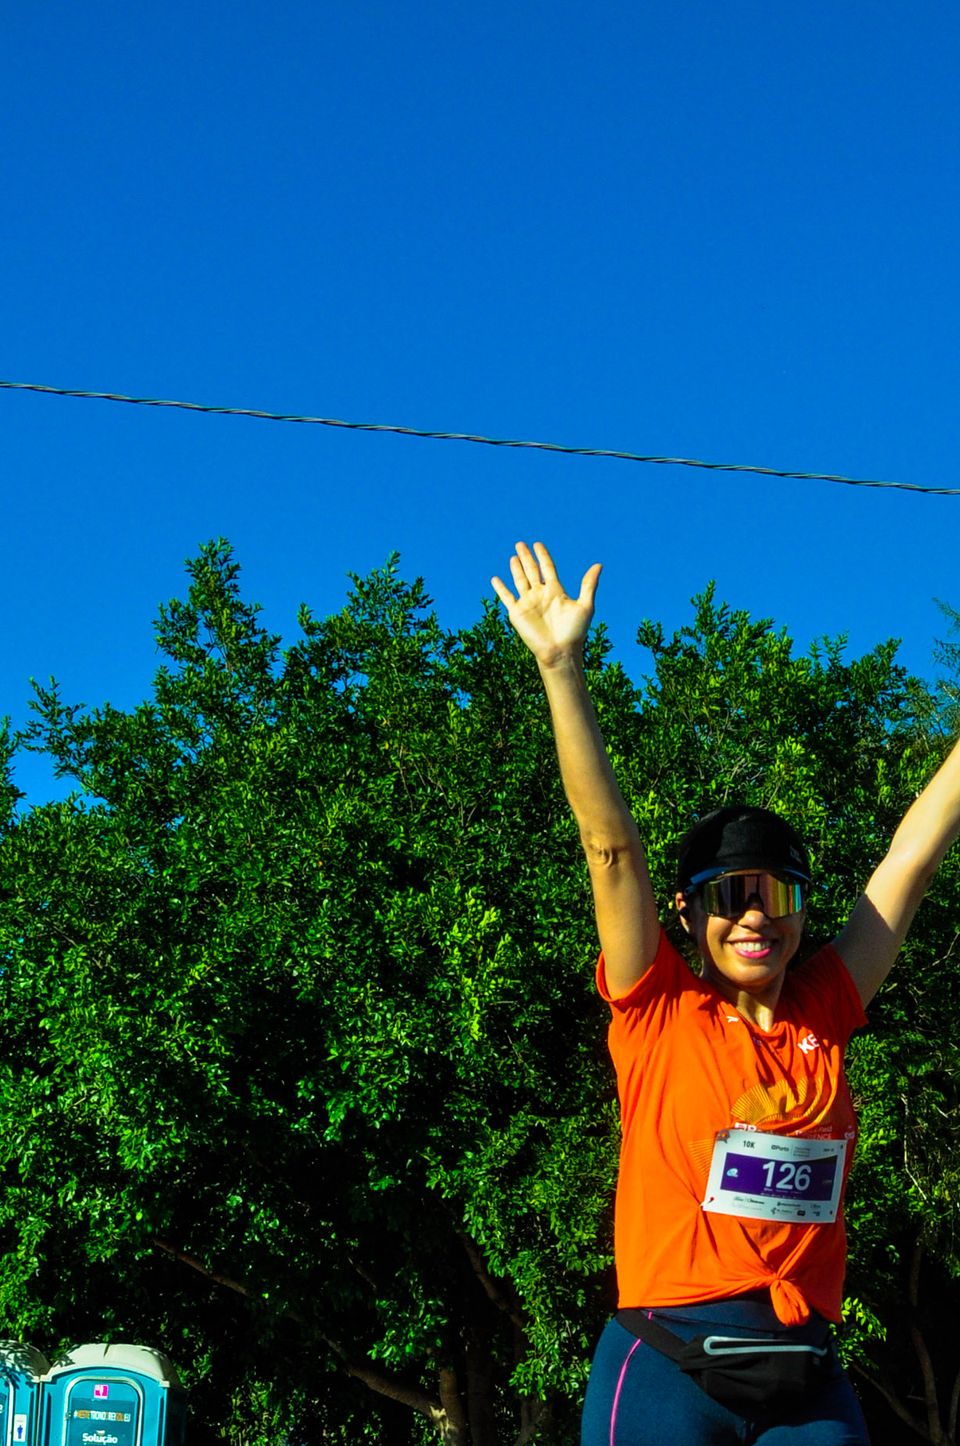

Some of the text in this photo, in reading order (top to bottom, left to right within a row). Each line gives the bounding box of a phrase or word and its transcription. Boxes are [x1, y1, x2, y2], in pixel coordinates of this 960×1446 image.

[743, 1140, 755, 1149] 10K
[762, 1161, 812, 1191] 126
[82, 1432, 118, 1445] Solução
